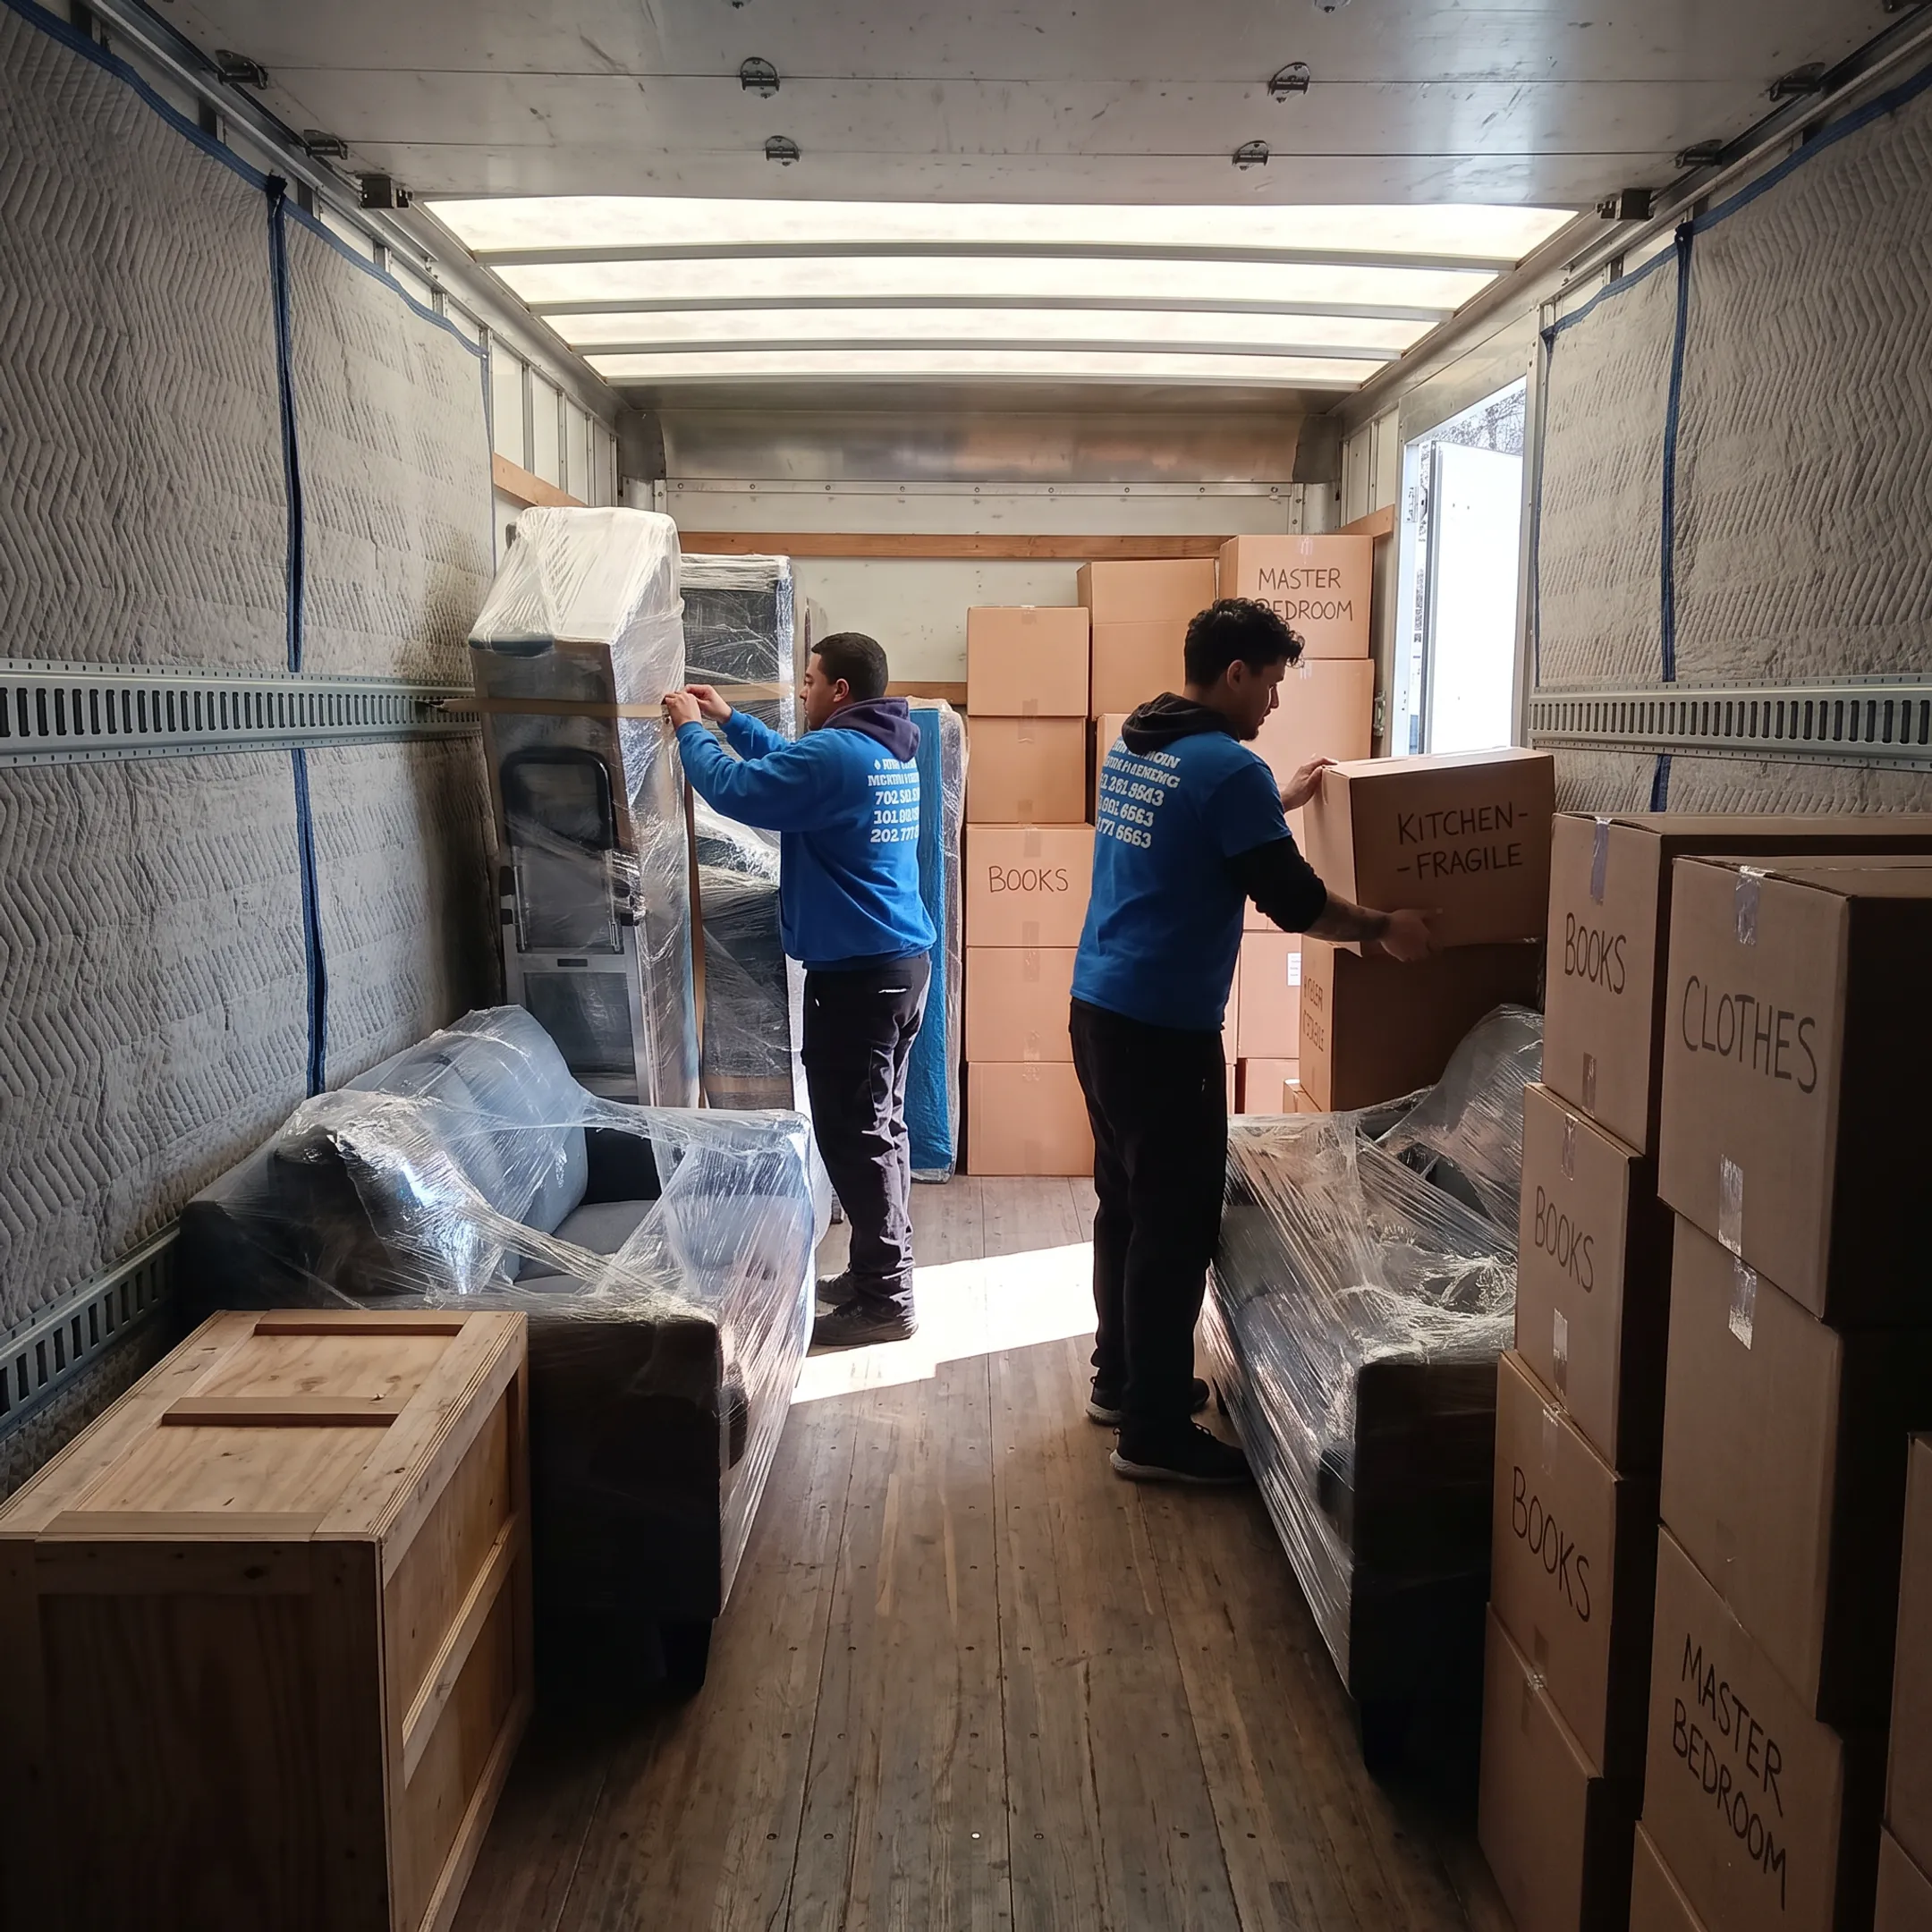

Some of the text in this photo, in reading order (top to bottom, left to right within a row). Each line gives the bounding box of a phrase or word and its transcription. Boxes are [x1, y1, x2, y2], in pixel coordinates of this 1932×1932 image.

[1258, 567, 1342, 591] MASTER
[870, 828, 900, 843] 202
[875, 790, 900, 805] 702
[988, 865, 1069, 893] BOOKS
[1563, 911, 1627, 995] BOOKS
[1682, 975, 1818, 1094] CLOTHES
[1535, 1185, 1594, 1293] BOOKS
[1512, 1465, 1591, 1623] BOOKS
[1682, 1632, 1784, 1819] MASTER
[1673, 1697, 1786, 1911] BEDROOM
